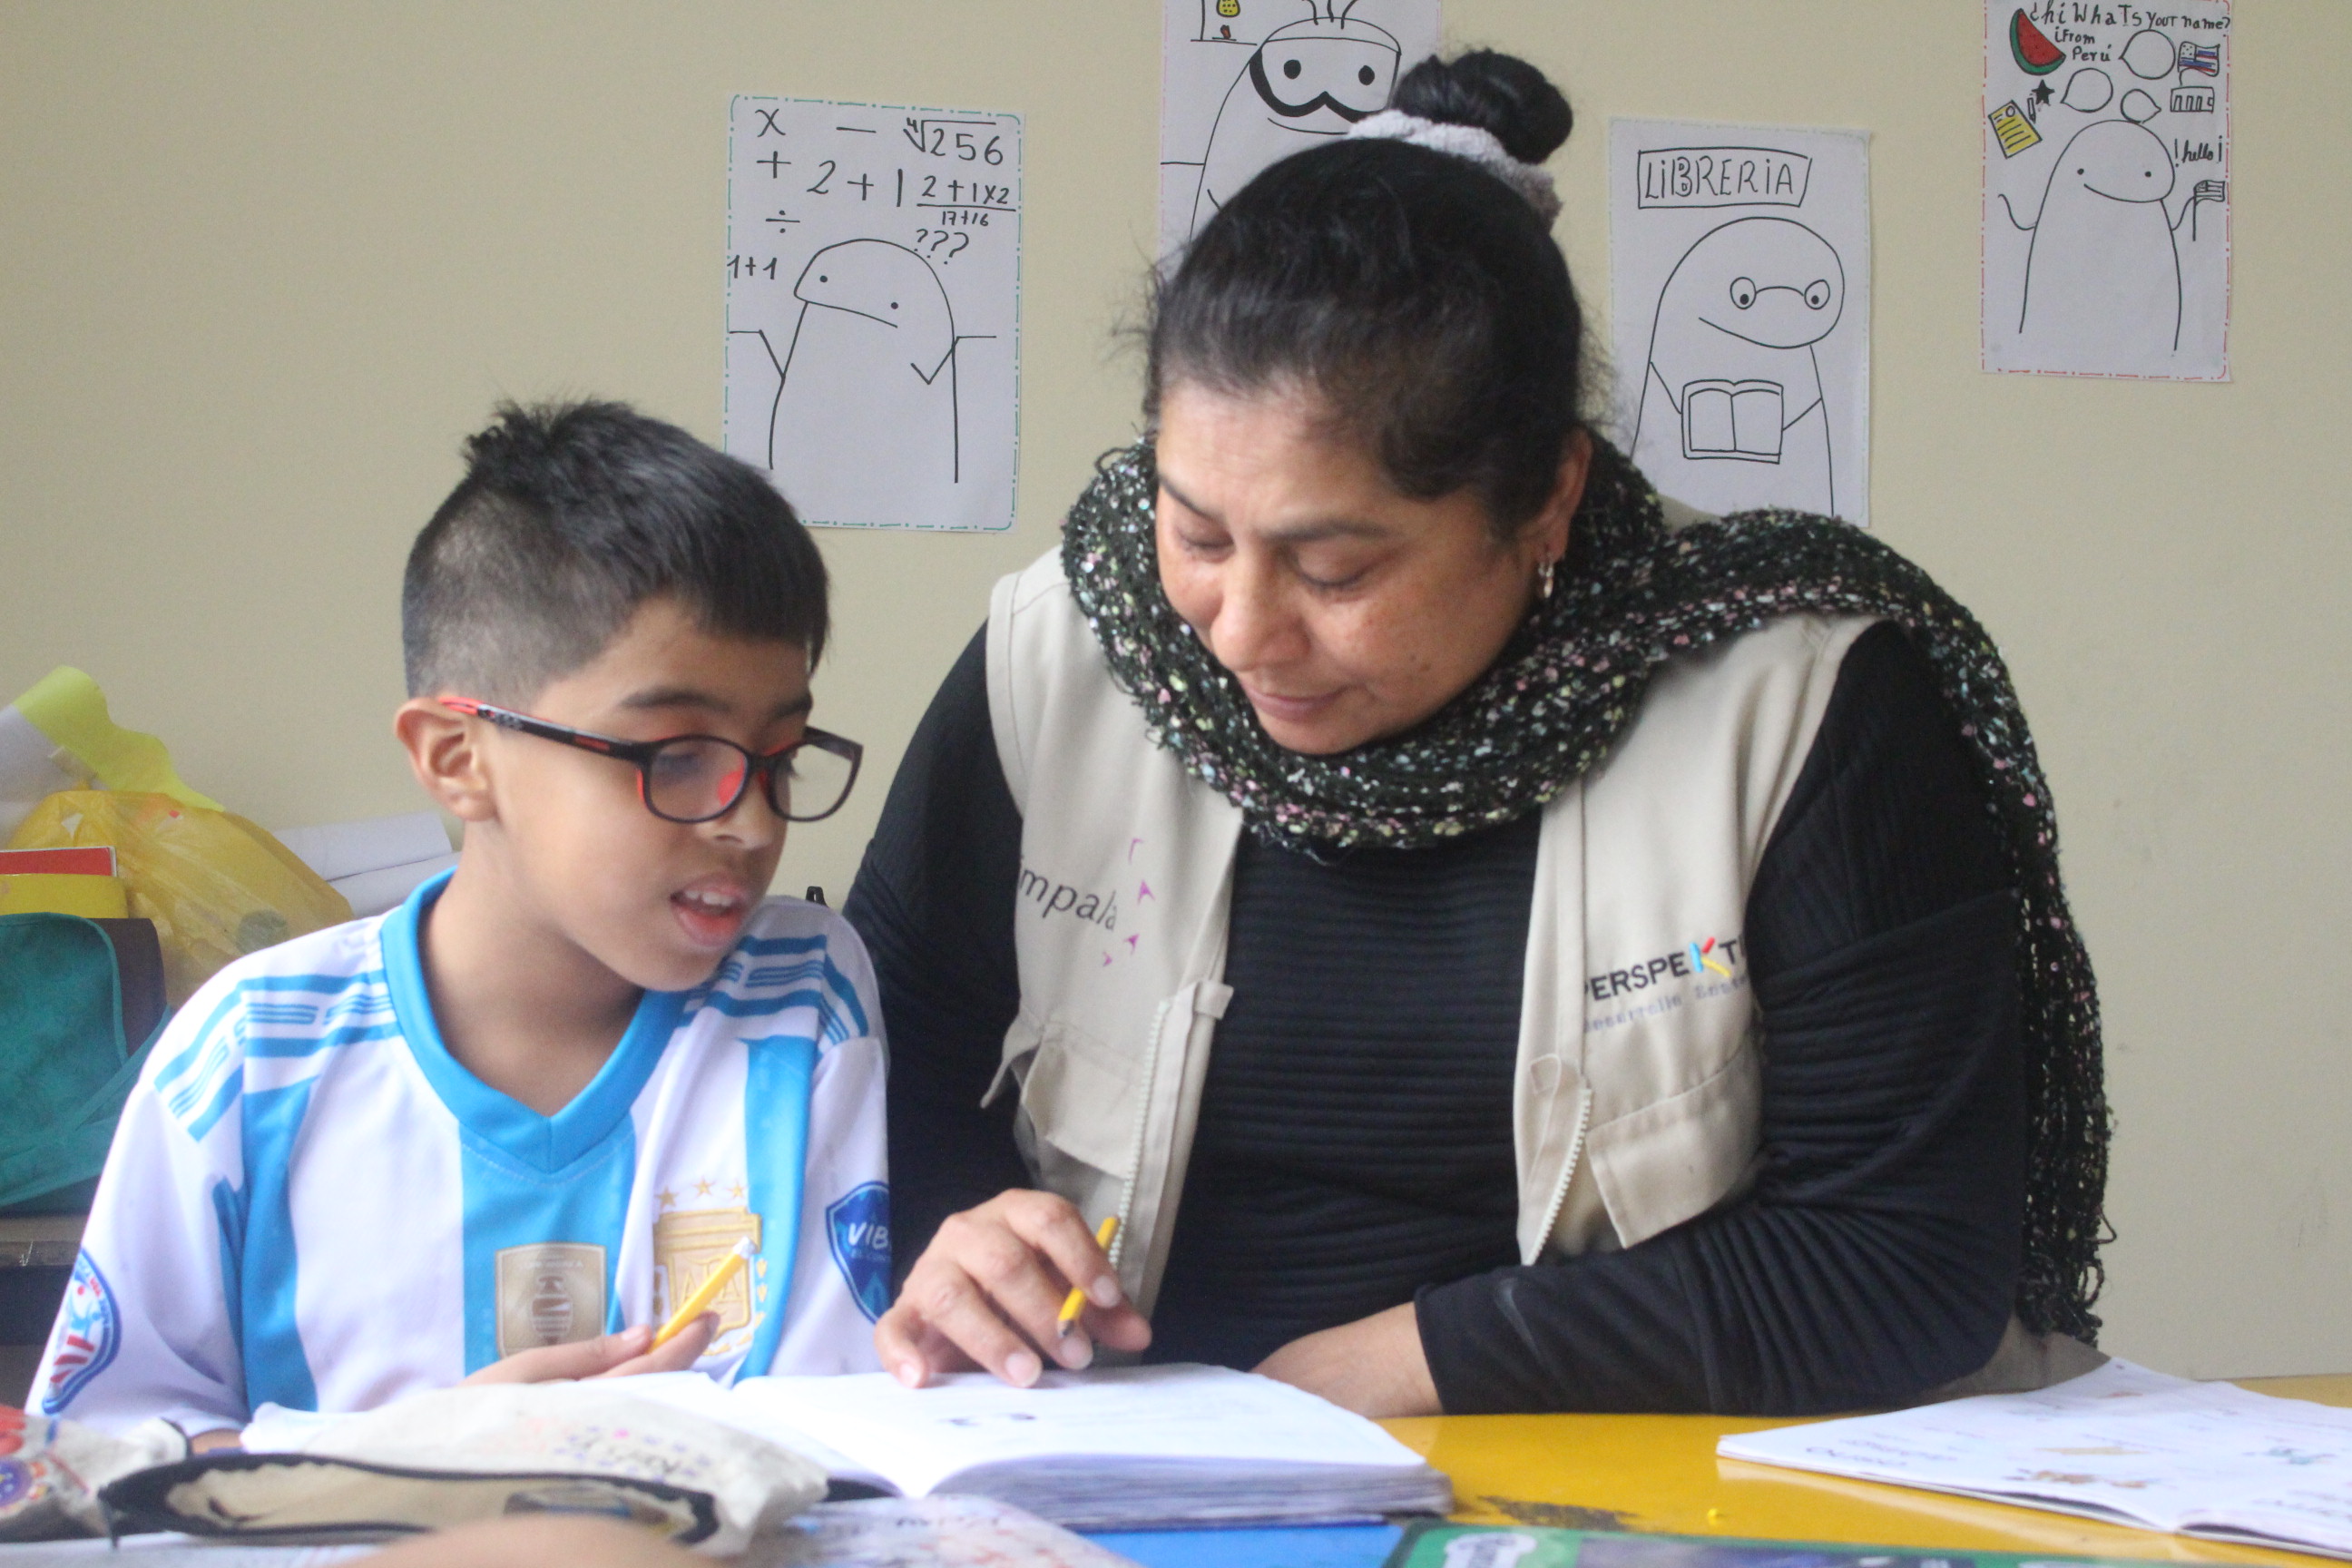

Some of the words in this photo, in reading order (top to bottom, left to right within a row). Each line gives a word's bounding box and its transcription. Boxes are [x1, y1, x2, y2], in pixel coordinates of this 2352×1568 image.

[1020, 868, 1117, 931] mpala
[1584, 936, 1744, 1001] ERSPEKT
[848, 1222, 889, 1250] VIB
